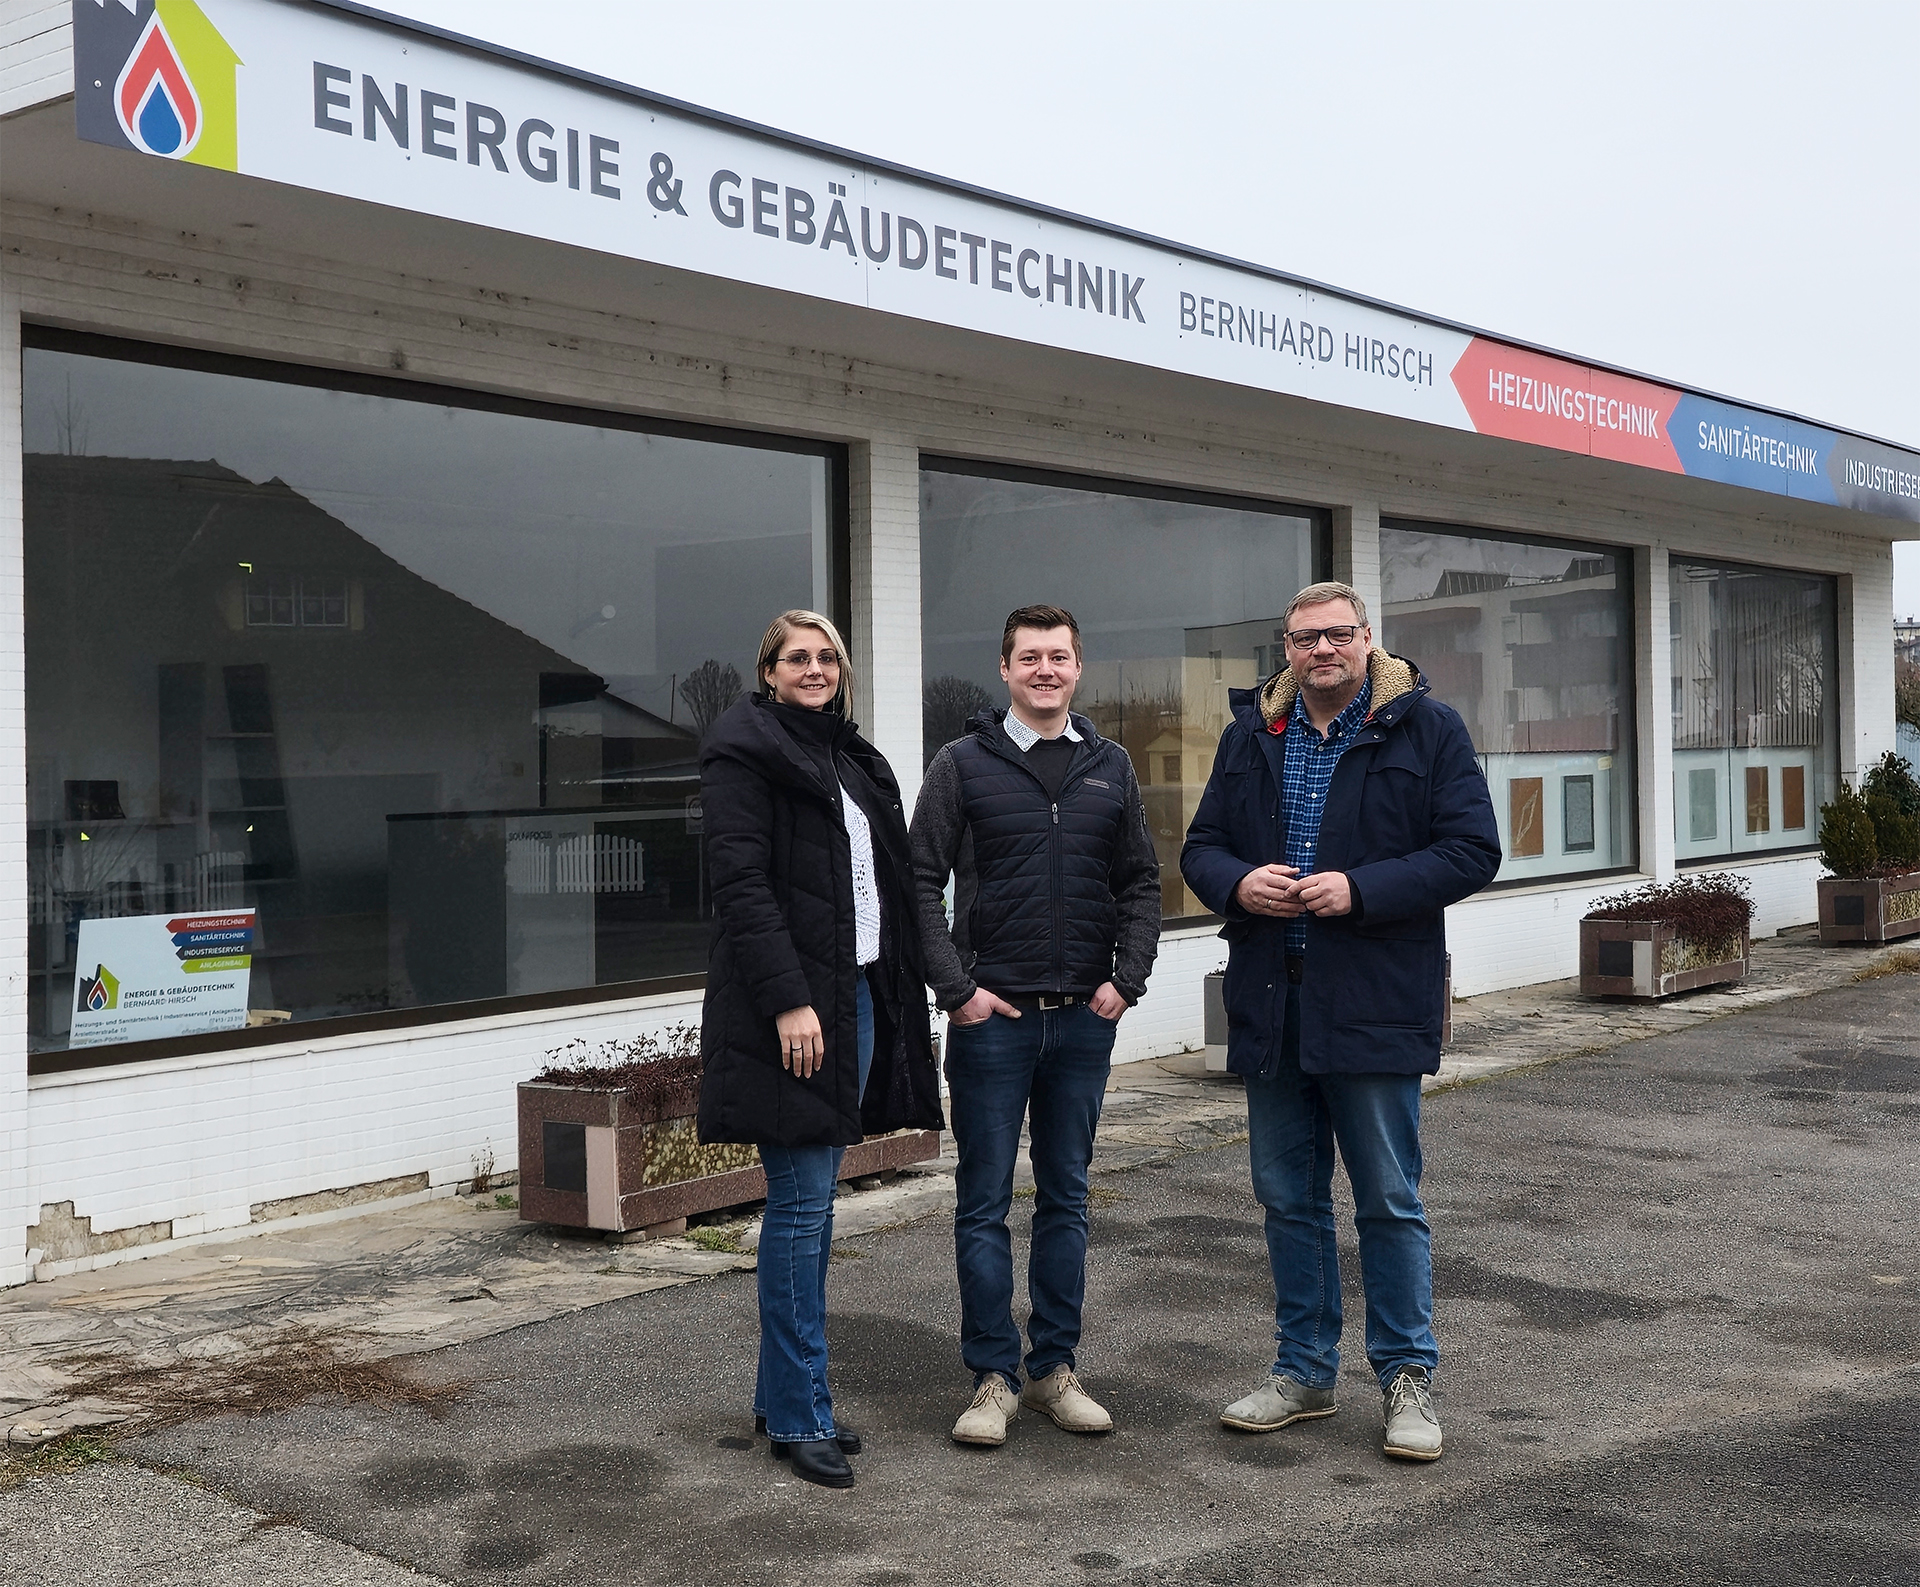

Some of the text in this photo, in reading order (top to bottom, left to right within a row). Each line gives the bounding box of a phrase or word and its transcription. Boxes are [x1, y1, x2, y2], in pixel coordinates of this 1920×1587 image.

[313, 60, 1433, 386] ENERGIE & GEBÄUDETECHNIK BERNHARD HIRSCH
[1488, 368, 1659, 439] HEIZUNGSTECHNIK
[1697, 420, 1818, 476] SANITÄRTECHNIK
[186, 917, 247, 929] HEIZUNGSTECHNIK
[190, 931, 246, 943] SANITÄRTECHNIK
[184, 945, 245, 957] INDUSTRIESERVICE
[199, 959, 244, 969] ANLAGENBAU
[124, 982, 235, 999] ENERGIE & GEBÄUDETECHNIK
[123, 995, 197, 1009] BERNHARD HIRSCH
